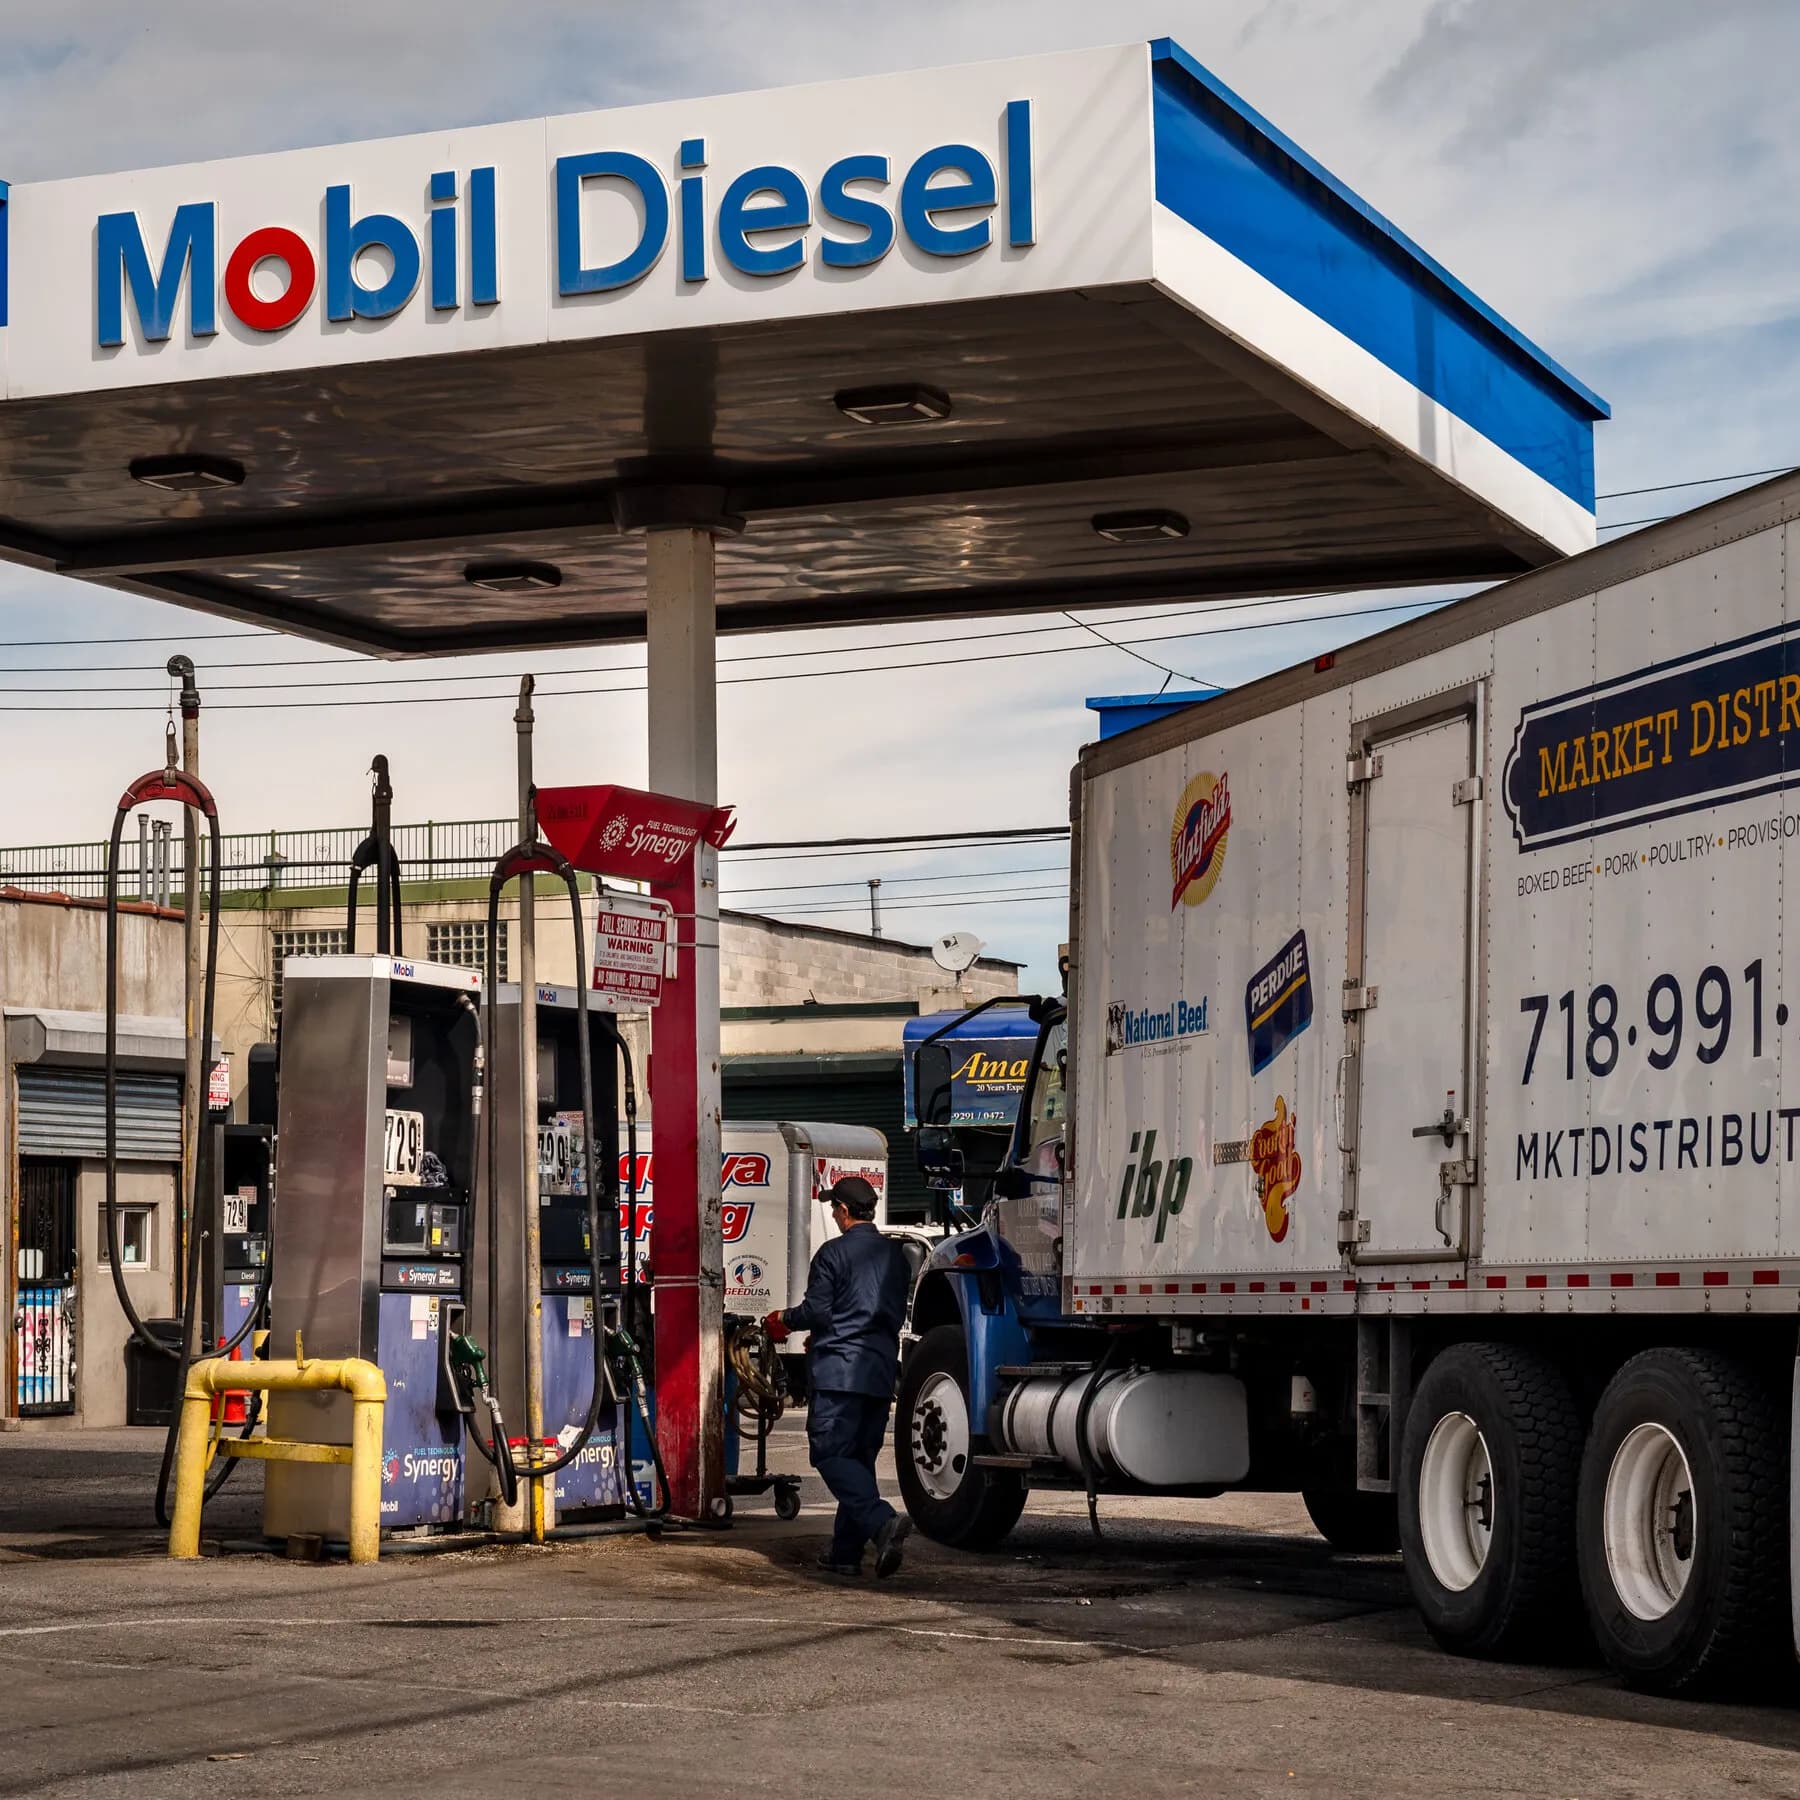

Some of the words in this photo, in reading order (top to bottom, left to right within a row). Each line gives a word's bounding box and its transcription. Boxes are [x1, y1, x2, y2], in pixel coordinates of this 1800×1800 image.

[98, 166, 501, 348] Mobil
[556, 98, 1036, 296] Diesel
[1538, 709, 1678, 798] MARKET
[1690, 673, 1800, 757] DISTR
[646, 820, 660, 830] FUEL
[661, 823, 698, 837] TECHNOLOGY
[1174, 770, 1230, 885] Hatfield
[625, 824, 692, 864] Synergy
[1518, 870, 1559, 897] BOXED
[1563, 861, 1592, 887] BEEF
[1604, 851, 1638, 878] PORK
[1650, 833, 1713, 867] POULTRY
[601, 914, 615, 933] FULL
[616, 917, 640, 936] SERVICE
[640, 921, 662, 939] ISLAND
[607, 937, 654, 954] WARNING
[393, 962, 415, 978] Mobil
[1251, 942, 1303, 1013] PERDUE
[538, 989, 557, 1003] Mobil
[1125, 1003, 1174, 1045] National
[1177, 996, 1207, 1035] Beef
[976, 1084, 985, 1092] 20
[986, 1084, 1005, 1092] Years
[984, 1112, 1005, 1120] 0472
[1116, 1129, 1193, 1243] ibp
[241, 1272, 255, 1280] Diesel
[409, 1269, 437, 1285] Synergy
[565, 1272, 591, 1287] Synergy
[404, 1454, 459, 1483] Synergy
[380, 1500, 399, 1512] Mobil
